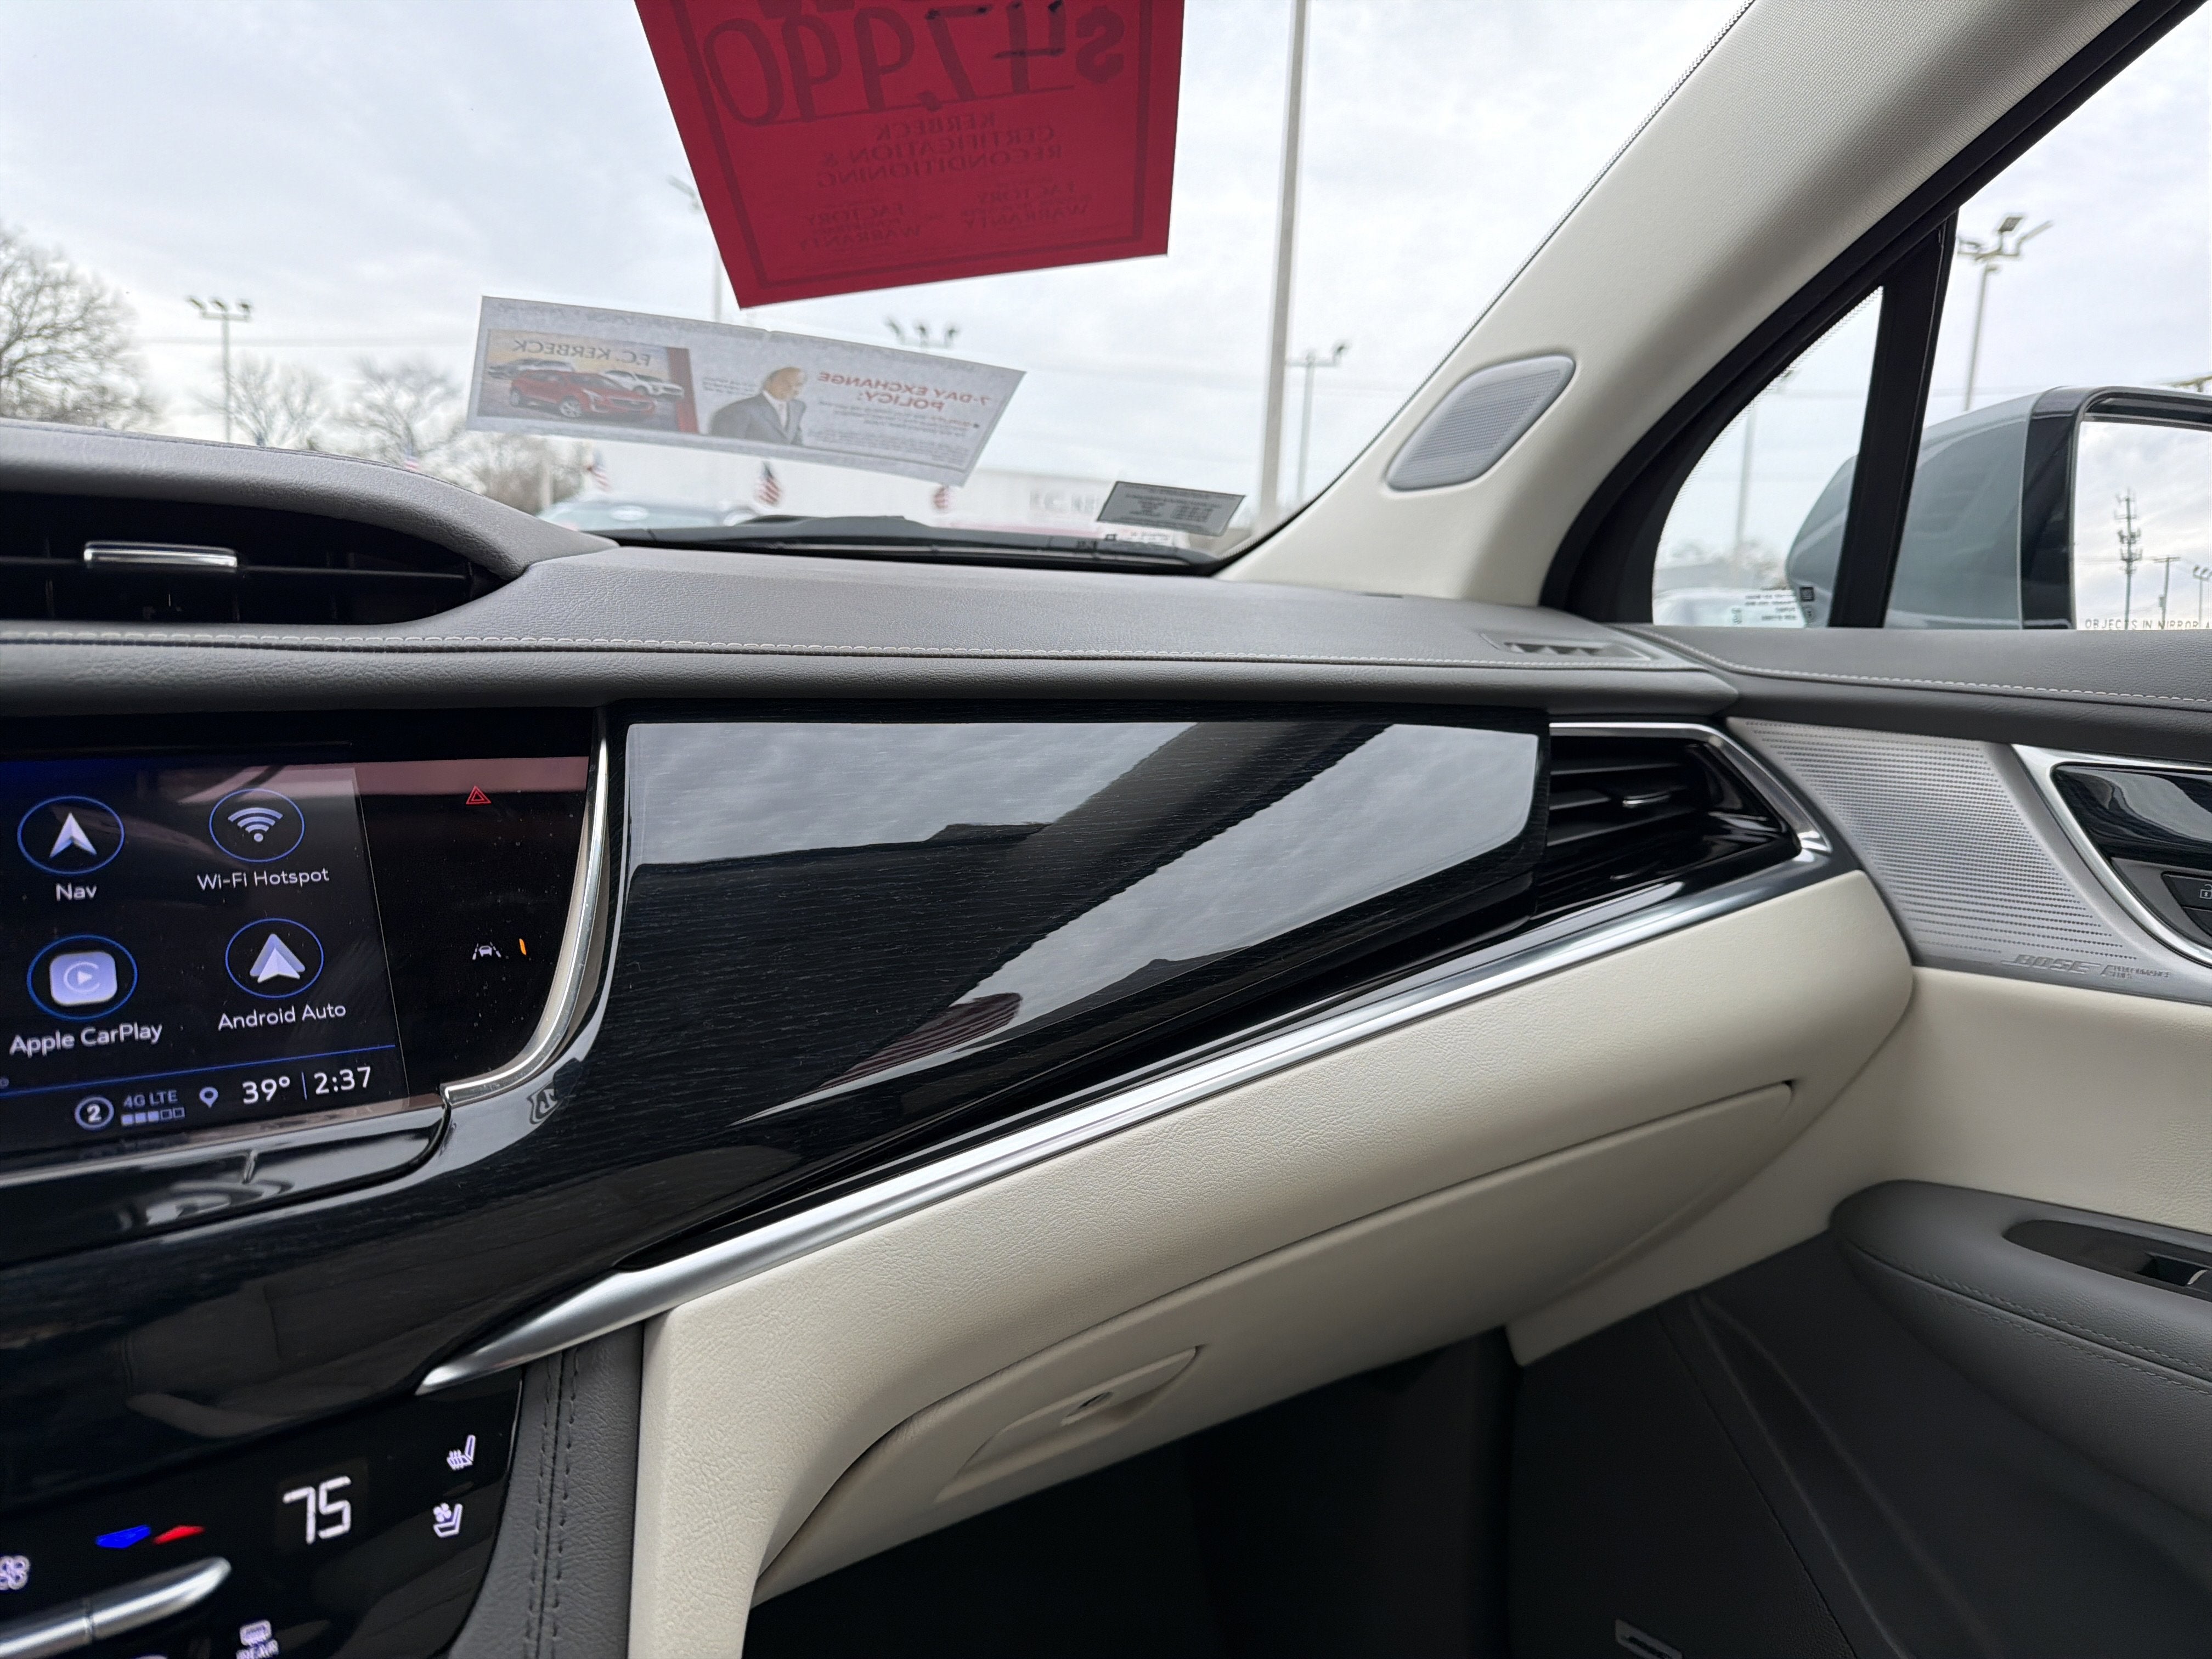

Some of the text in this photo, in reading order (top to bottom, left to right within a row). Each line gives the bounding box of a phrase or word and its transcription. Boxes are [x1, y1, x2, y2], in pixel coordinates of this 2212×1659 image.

[2143, 619, 2152, 629] IN
[197, 867, 329, 890] Wi-Fi Hotspot
[55, 883, 97, 900] Nav
[2001, 953, 2101, 974] BOSE
[218, 1003, 346, 1030] Android Auto
[10, 1022, 162, 1057] Apple CarPlay
[242, 1075, 290, 1104] 39°
[314, 1066, 371, 1094] 2:37
[123, 1090, 177, 1108] 4G LTE
[283, 1476, 351, 1544] 75
